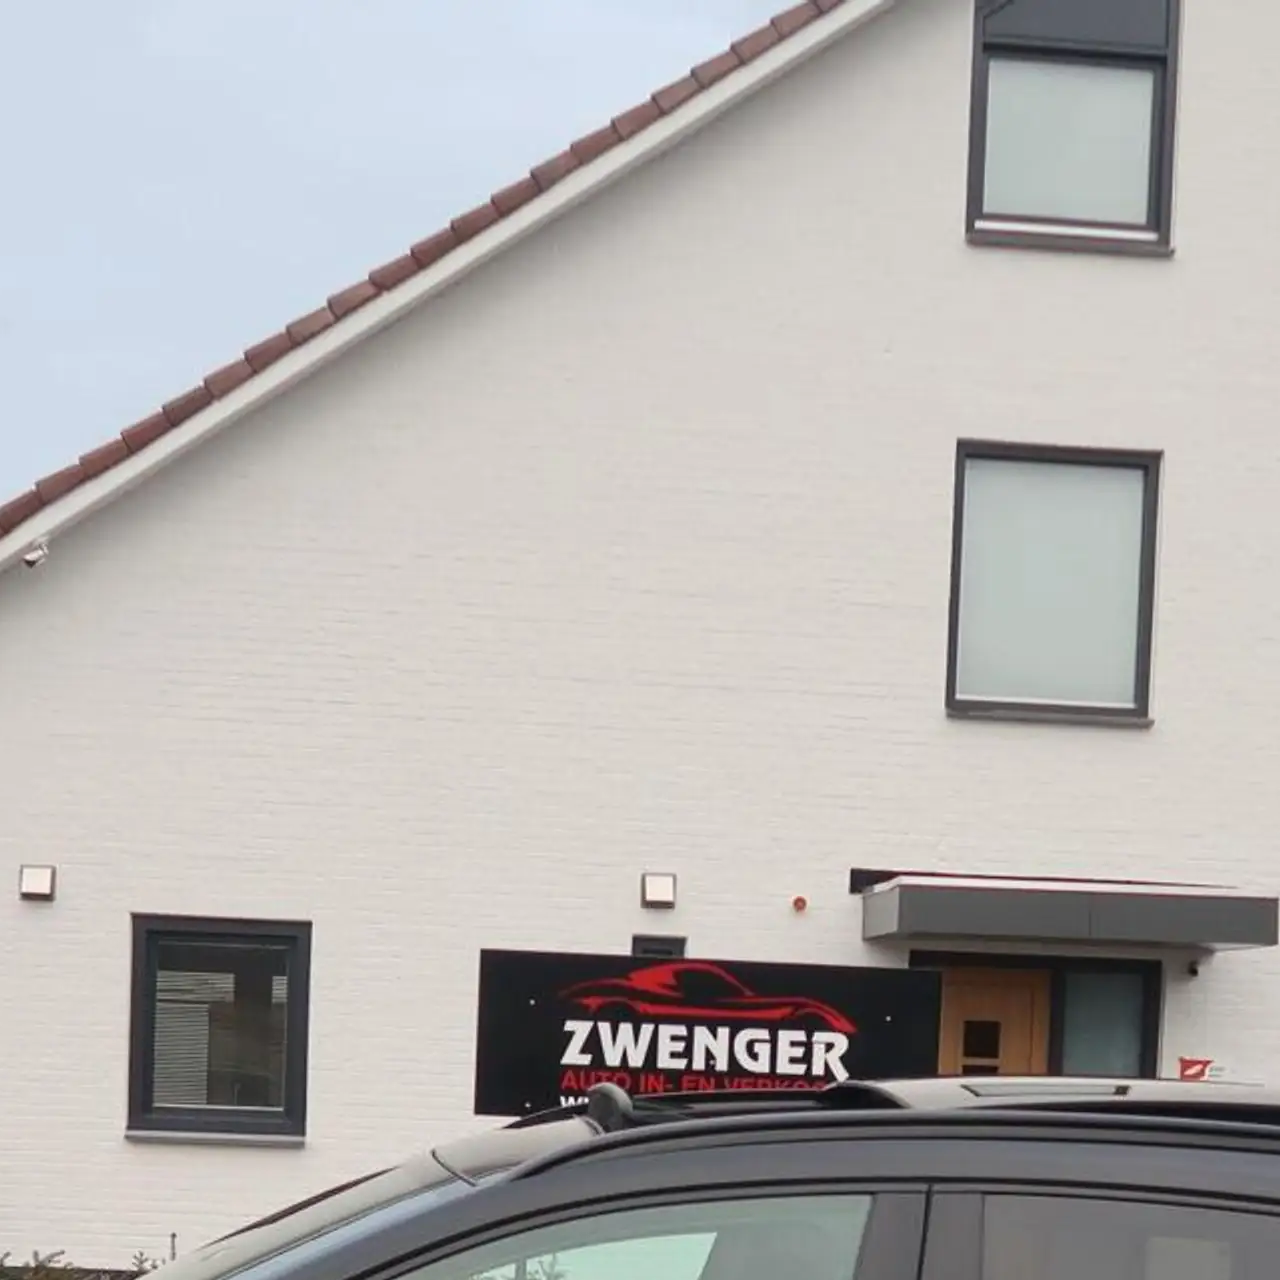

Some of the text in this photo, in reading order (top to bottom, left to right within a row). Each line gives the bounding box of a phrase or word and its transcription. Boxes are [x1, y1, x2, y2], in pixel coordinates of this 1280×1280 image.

[560, 1020, 851, 1082] ZWENGER
[561, 1069, 632, 1092] AUTO
[681, 1074, 715, 1093] EN
